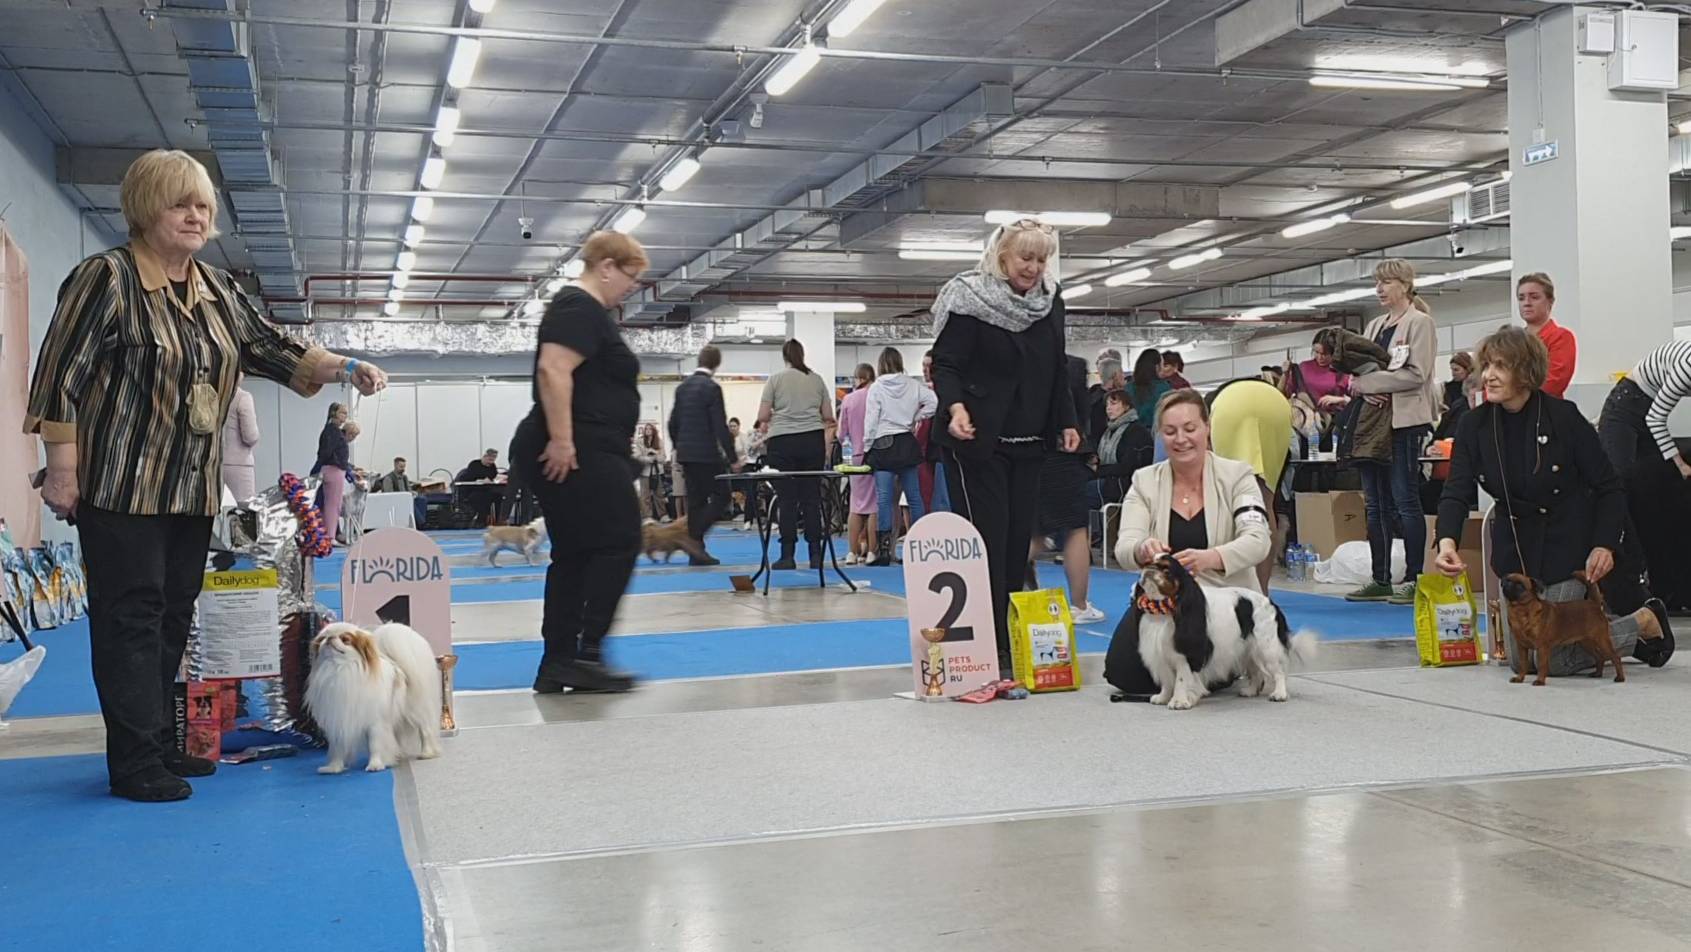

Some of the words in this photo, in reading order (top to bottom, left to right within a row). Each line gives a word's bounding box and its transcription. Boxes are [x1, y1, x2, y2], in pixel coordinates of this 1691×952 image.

[910, 537, 982, 562] FLORIDA
[350, 556, 443, 584] FLORIDA
[928, 571, 974, 642] 2
[948, 656, 971, 664] PETS
[949, 663, 991, 673] PRODUCT
